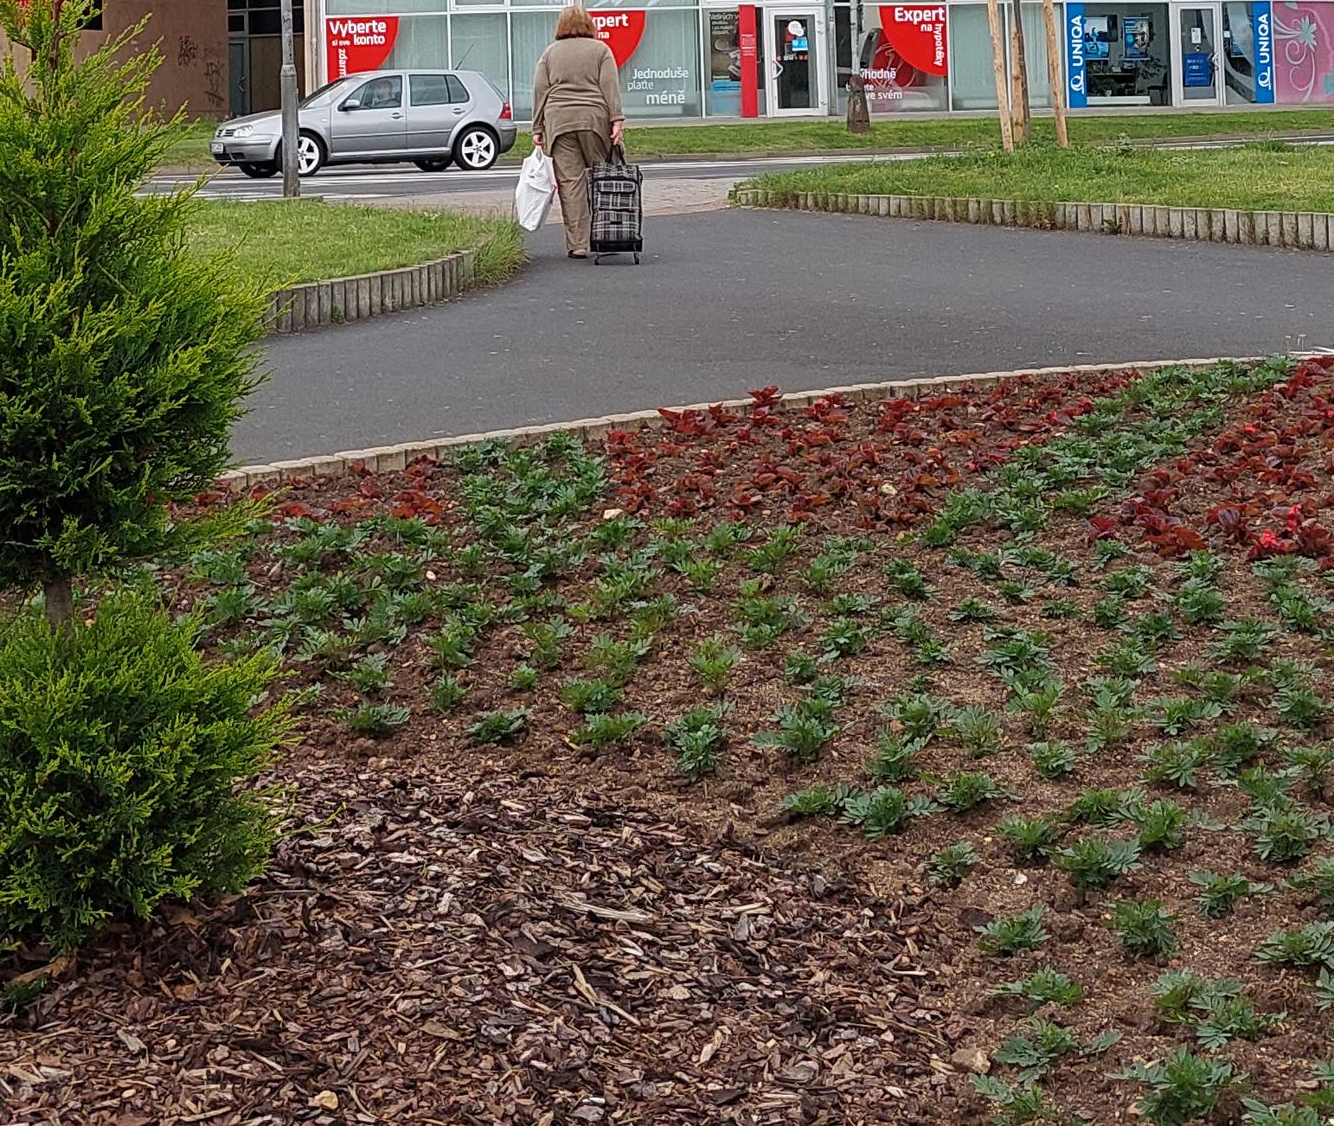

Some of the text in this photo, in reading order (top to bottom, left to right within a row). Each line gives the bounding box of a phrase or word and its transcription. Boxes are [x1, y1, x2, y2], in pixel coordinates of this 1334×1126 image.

[591, 13, 629, 30] pert
[894, 6, 946, 25] Expert
[328, 19, 387, 38] Vyberte
[598, 31, 610, 39] na
[920, 23, 933, 32] na
[331, 39, 338, 47] si
[353, 34, 386, 46] konto
[933, 23, 945, 67] hypotéky
[1071, 14, 1084, 67] UNIQA
[1258, 12, 1271, 64] UNIQA
[337, 48, 348, 79] zdarm
[632, 67, 689, 80] Jednoduše
[860, 67, 897, 80] hodně
[645, 89, 687, 106] méně
[877, 89, 903, 100] svém
